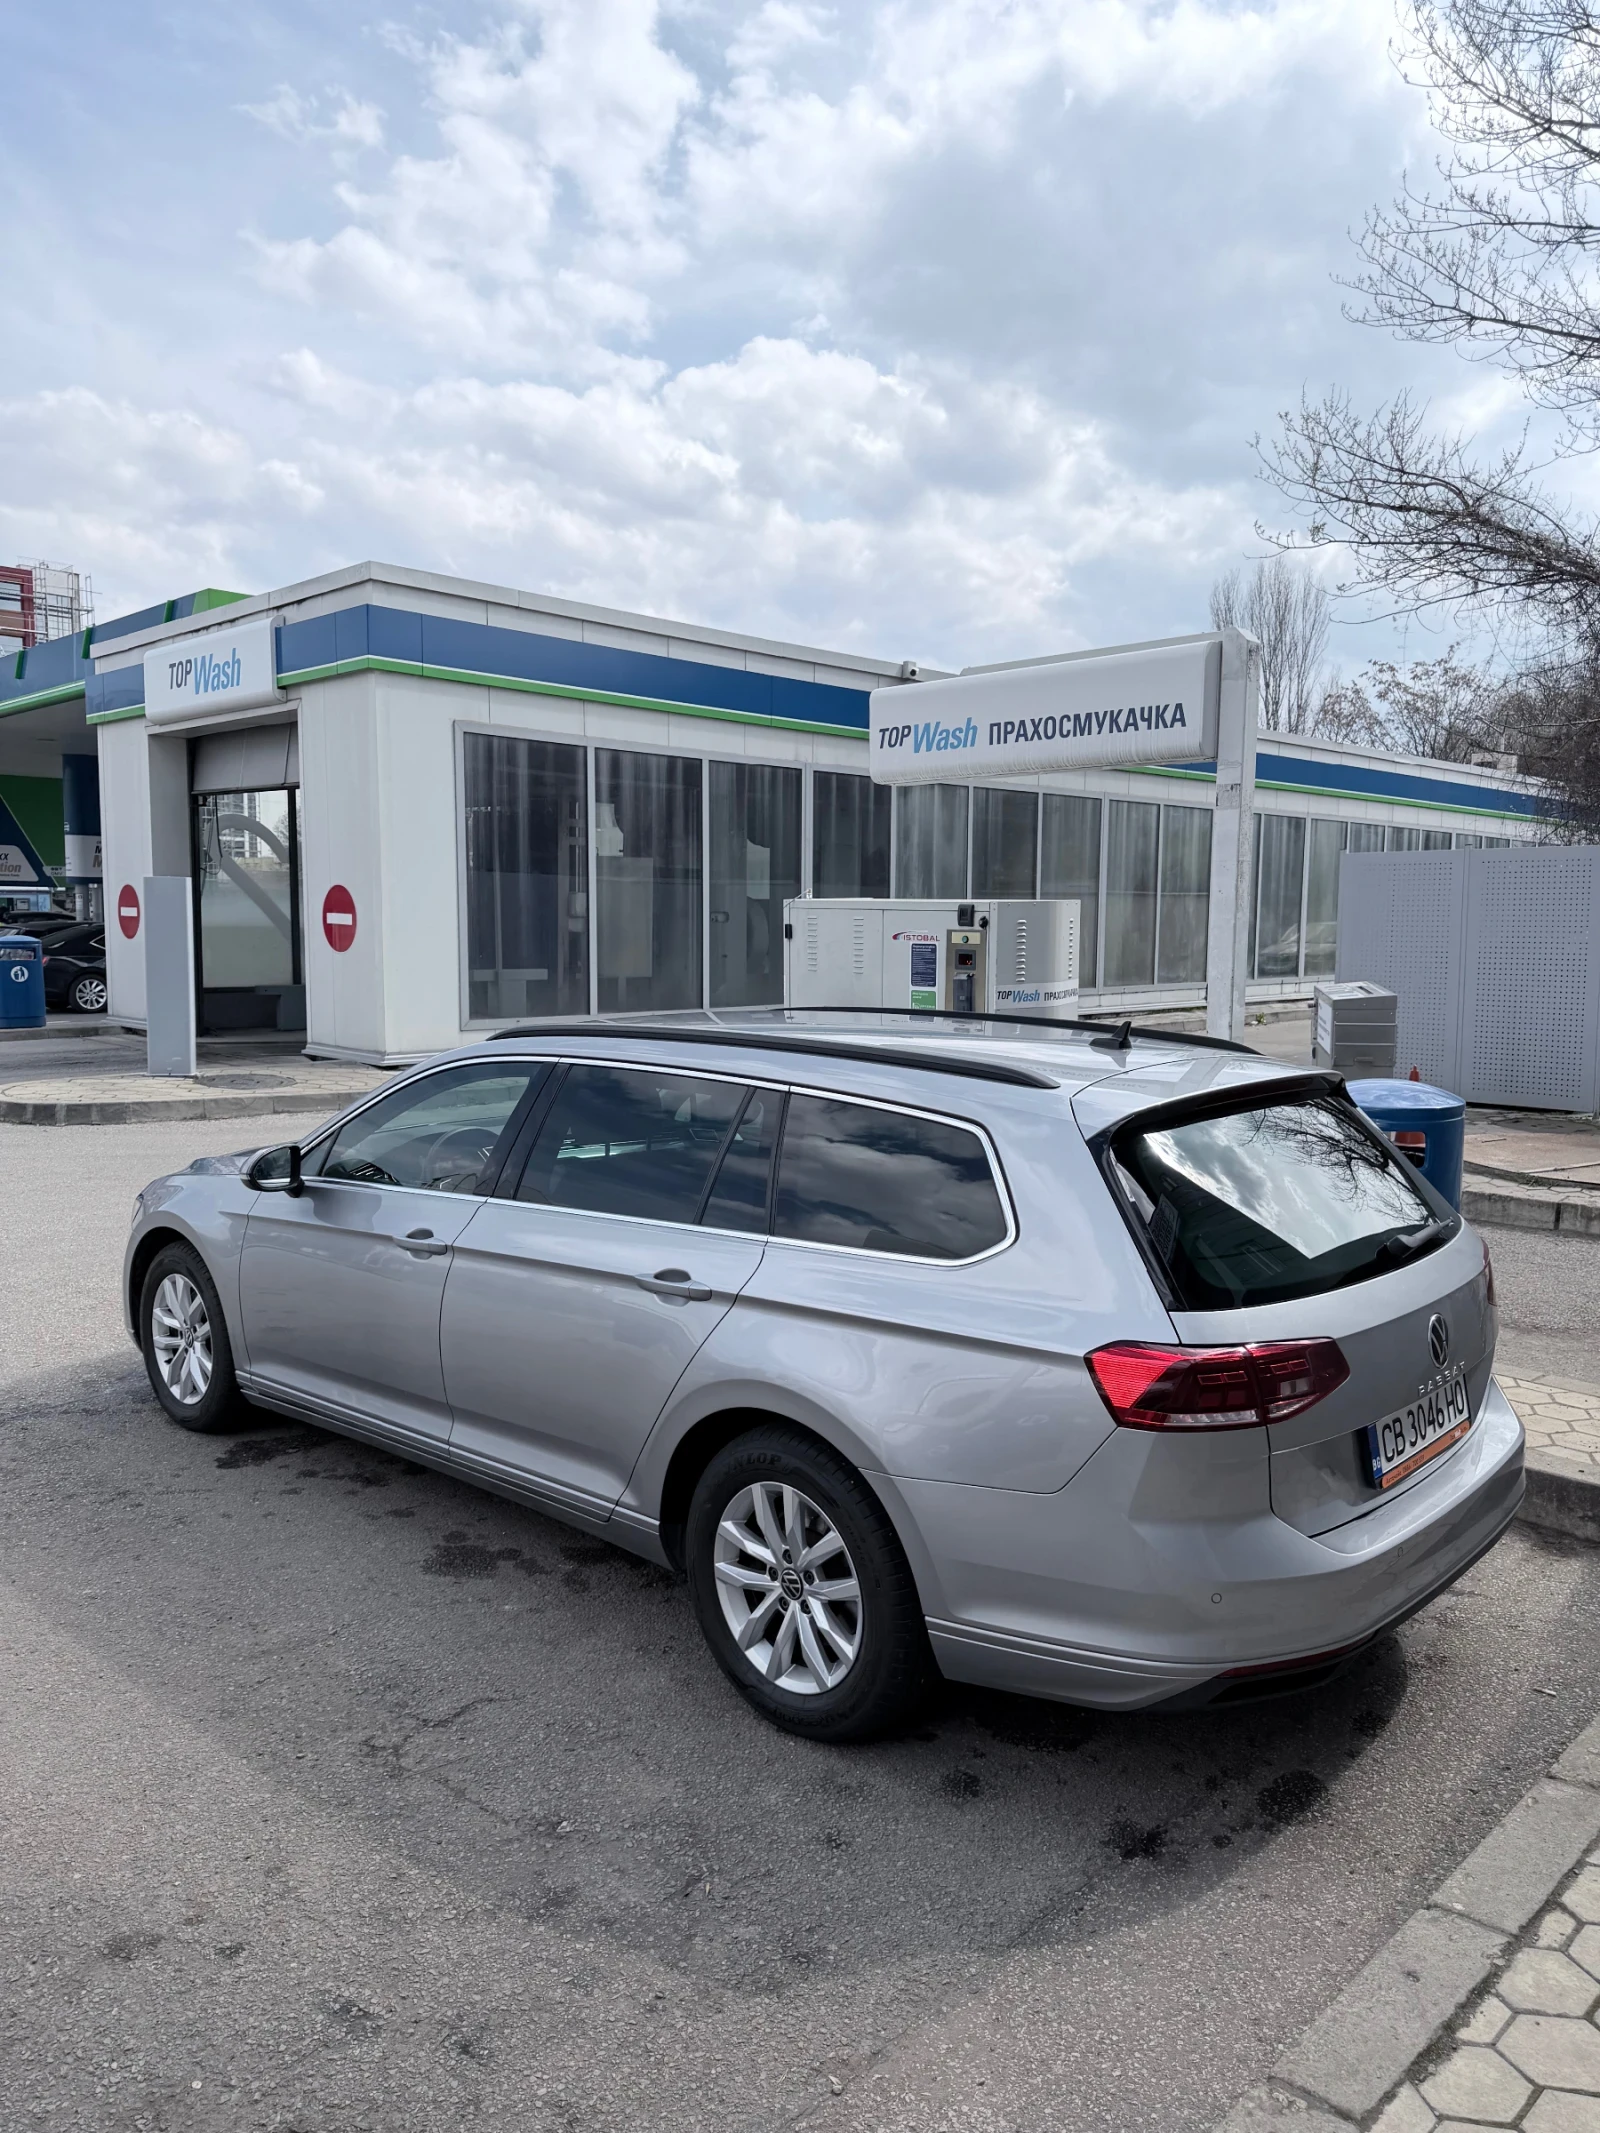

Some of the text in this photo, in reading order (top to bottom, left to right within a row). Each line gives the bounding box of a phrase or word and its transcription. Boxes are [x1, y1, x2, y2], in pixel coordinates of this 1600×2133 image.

[989, 702, 1187, 746] ПРАХОСМУКАЧКА
[903, 934, 941, 942] ISTOBAL
[1406, 1391, 1445, 1447] 3046
[1372, 1456, 1381, 1471] BG
